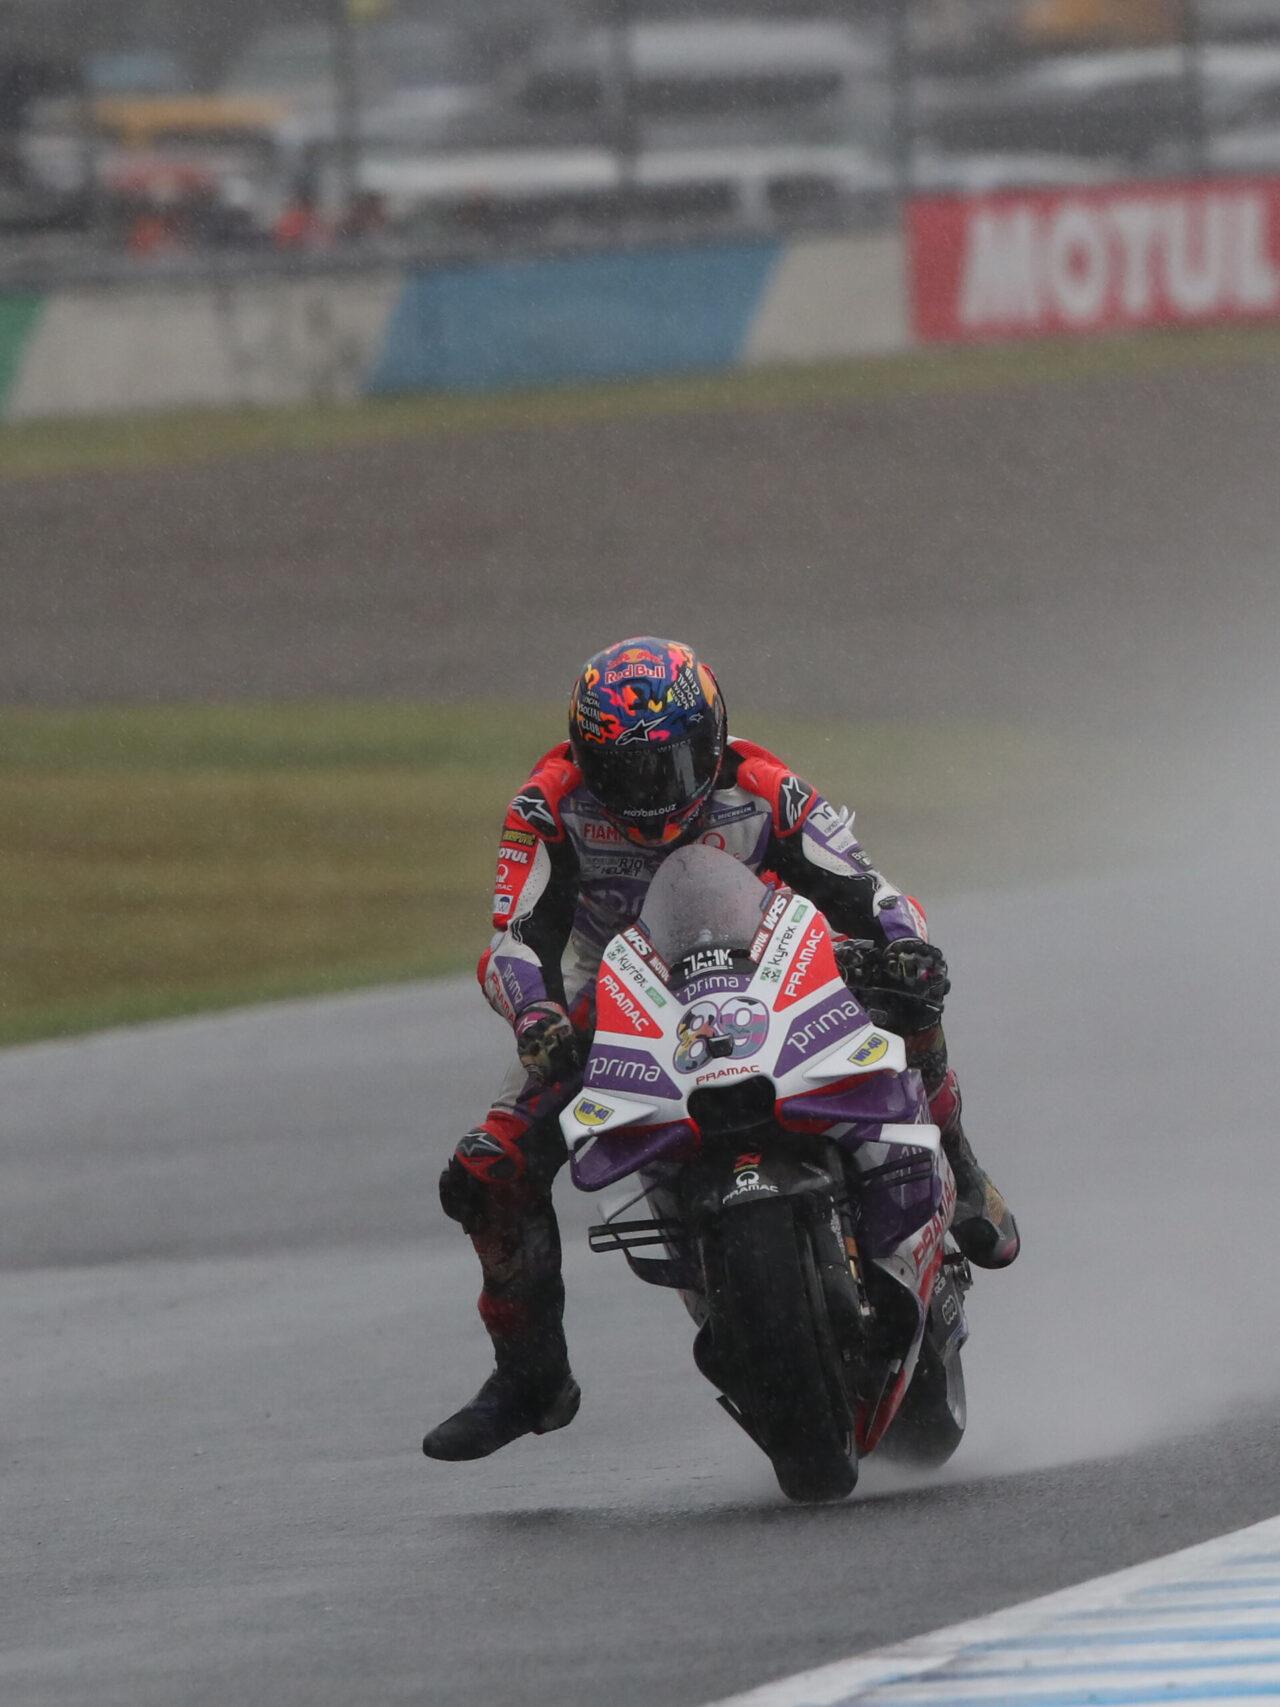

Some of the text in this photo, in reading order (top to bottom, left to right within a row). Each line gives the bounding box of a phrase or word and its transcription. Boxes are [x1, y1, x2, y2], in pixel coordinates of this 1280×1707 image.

[960, 195, 1280, 326] MOTUL
[605, 664, 665, 684] Red Bull
[624, 803, 677, 817] MOTOBLOUZ
[717, 806, 752, 820] MICHELIN
[584, 823, 623, 841] FIAM
[498, 849, 528, 864] OTUL
[749, 895, 788, 961] MOTUL WRS
[622, 927, 653, 957] WRS
[649, 956, 671, 982] MOTUL
[768, 925, 796, 966] kyrrex
[619, 952, 649, 988] kyrrex
[784, 928, 825, 997] PRAMAC
[502, 962, 524, 1002] prima
[684, 976, 739, 1000] prima
[599, 974, 650, 1032] PRAMAC
[673, 996, 770, 1074] 89
[787, 999, 861, 1054] prima
[852, 1036, 883, 1063] WD-40
[588, 1055, 661, 1083] prima
[696, 1065, 760, 1086] PRAMAC
[578, 1099, 609, 1119] WD-40
[722, 1184, 779, 1204] PRAMAC
